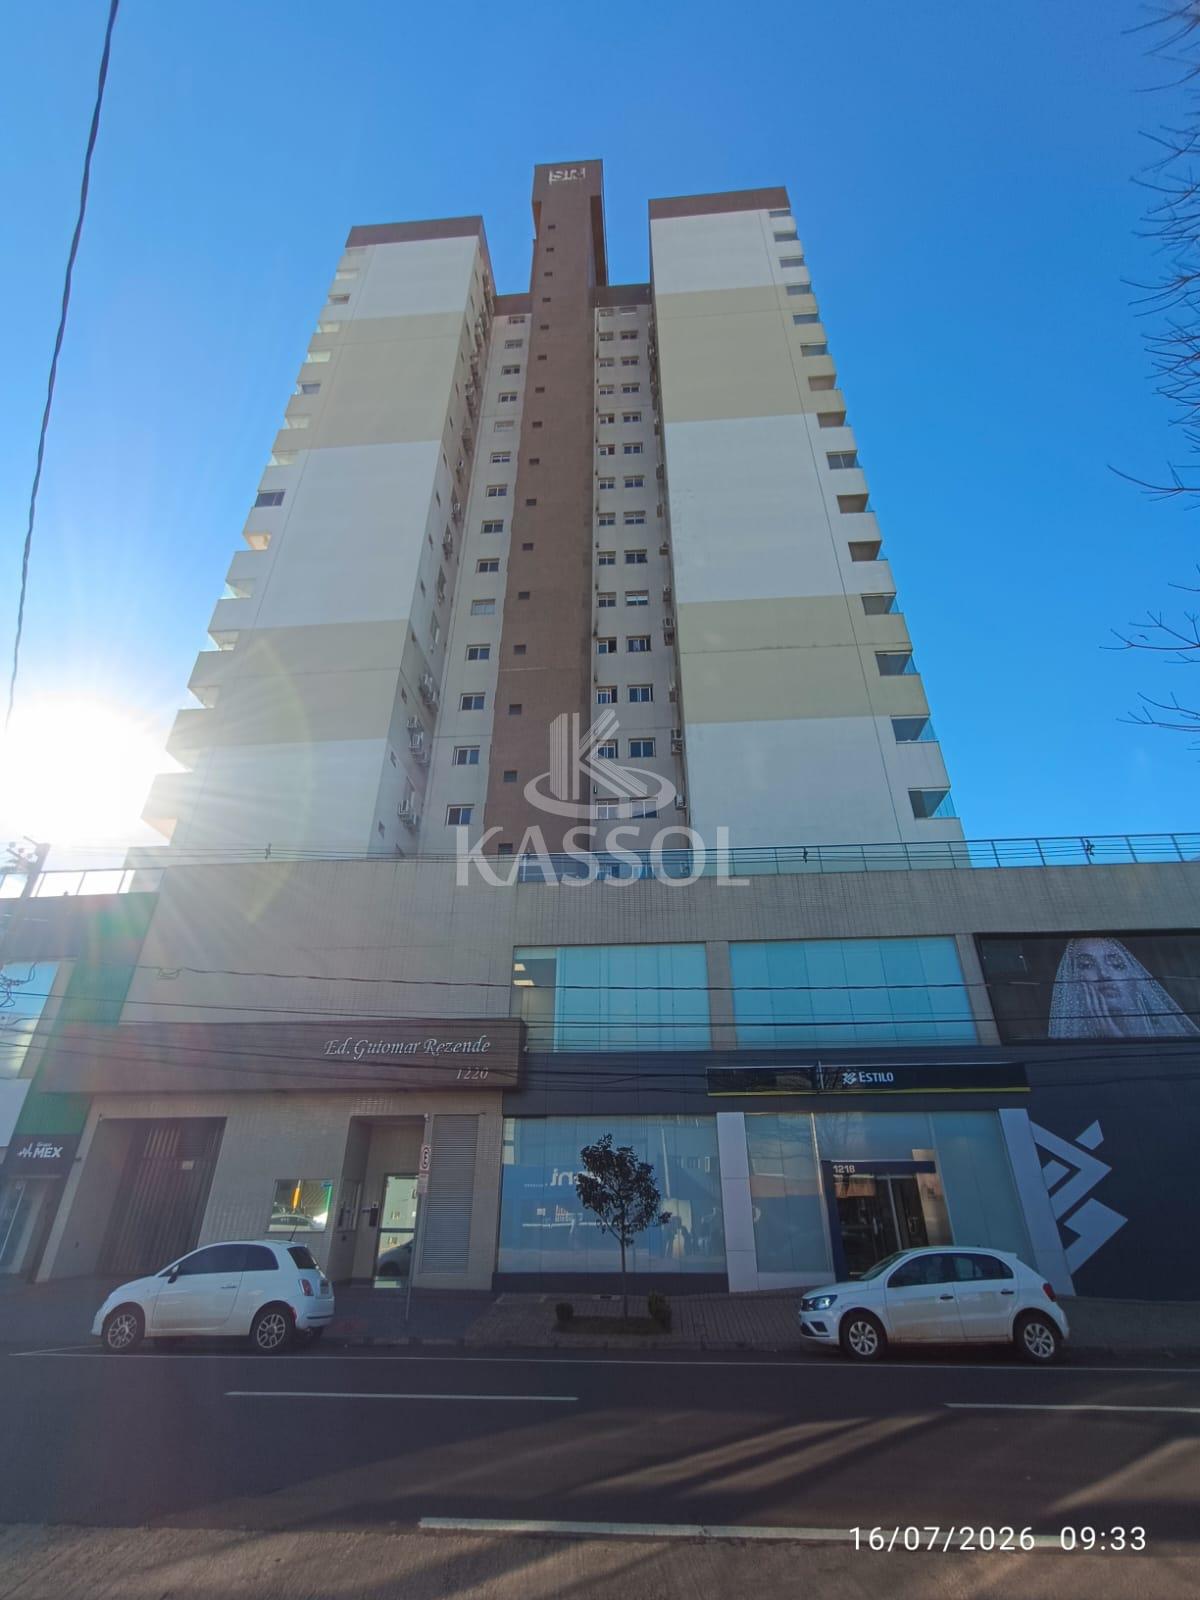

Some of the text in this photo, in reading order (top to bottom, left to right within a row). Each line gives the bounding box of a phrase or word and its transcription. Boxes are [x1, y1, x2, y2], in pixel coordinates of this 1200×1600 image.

[324, 1035, 491, 1060] Ed. Guiomar Rezende
[456, 1066, 489, 1080] 1220
[858, 1071, 894, 1084] ESTILO
[33, 1147, 63, 1158] MEX
[833, 1165, 855, 1174] 1218
